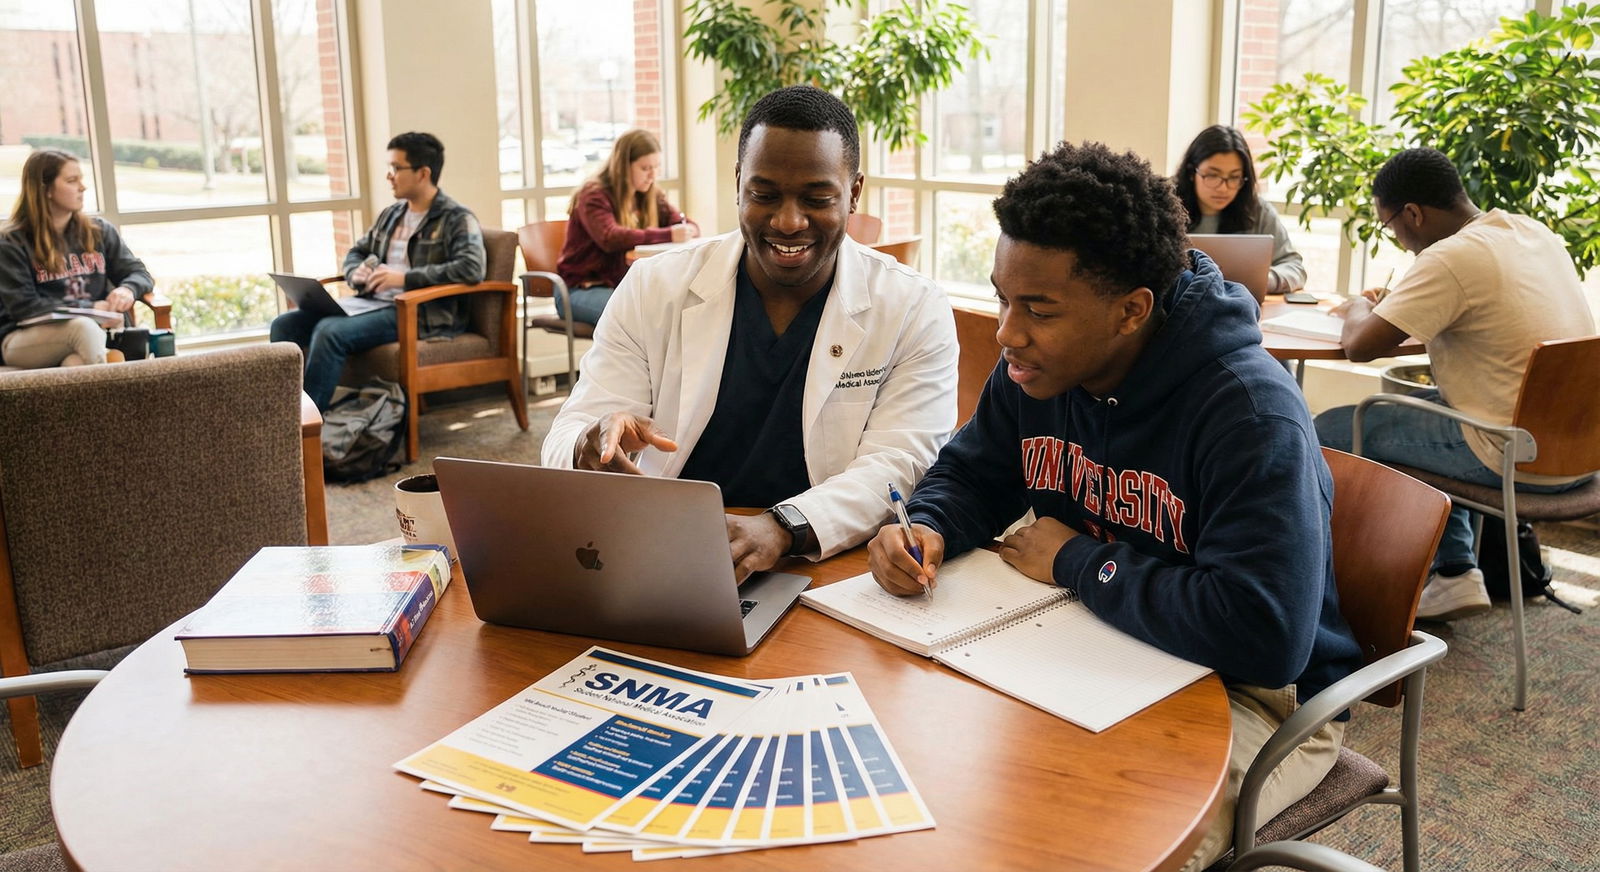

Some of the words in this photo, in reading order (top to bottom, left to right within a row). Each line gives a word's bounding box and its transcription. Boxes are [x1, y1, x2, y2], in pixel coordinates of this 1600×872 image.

[1021, 436, 1190, 554] UNIVERSITY
[574, 687, 604, 701] Student
[603, 694, 633, 707] National
[633, 703, 662, 715] Medical
[584, 672, 714, 719] SNMA
